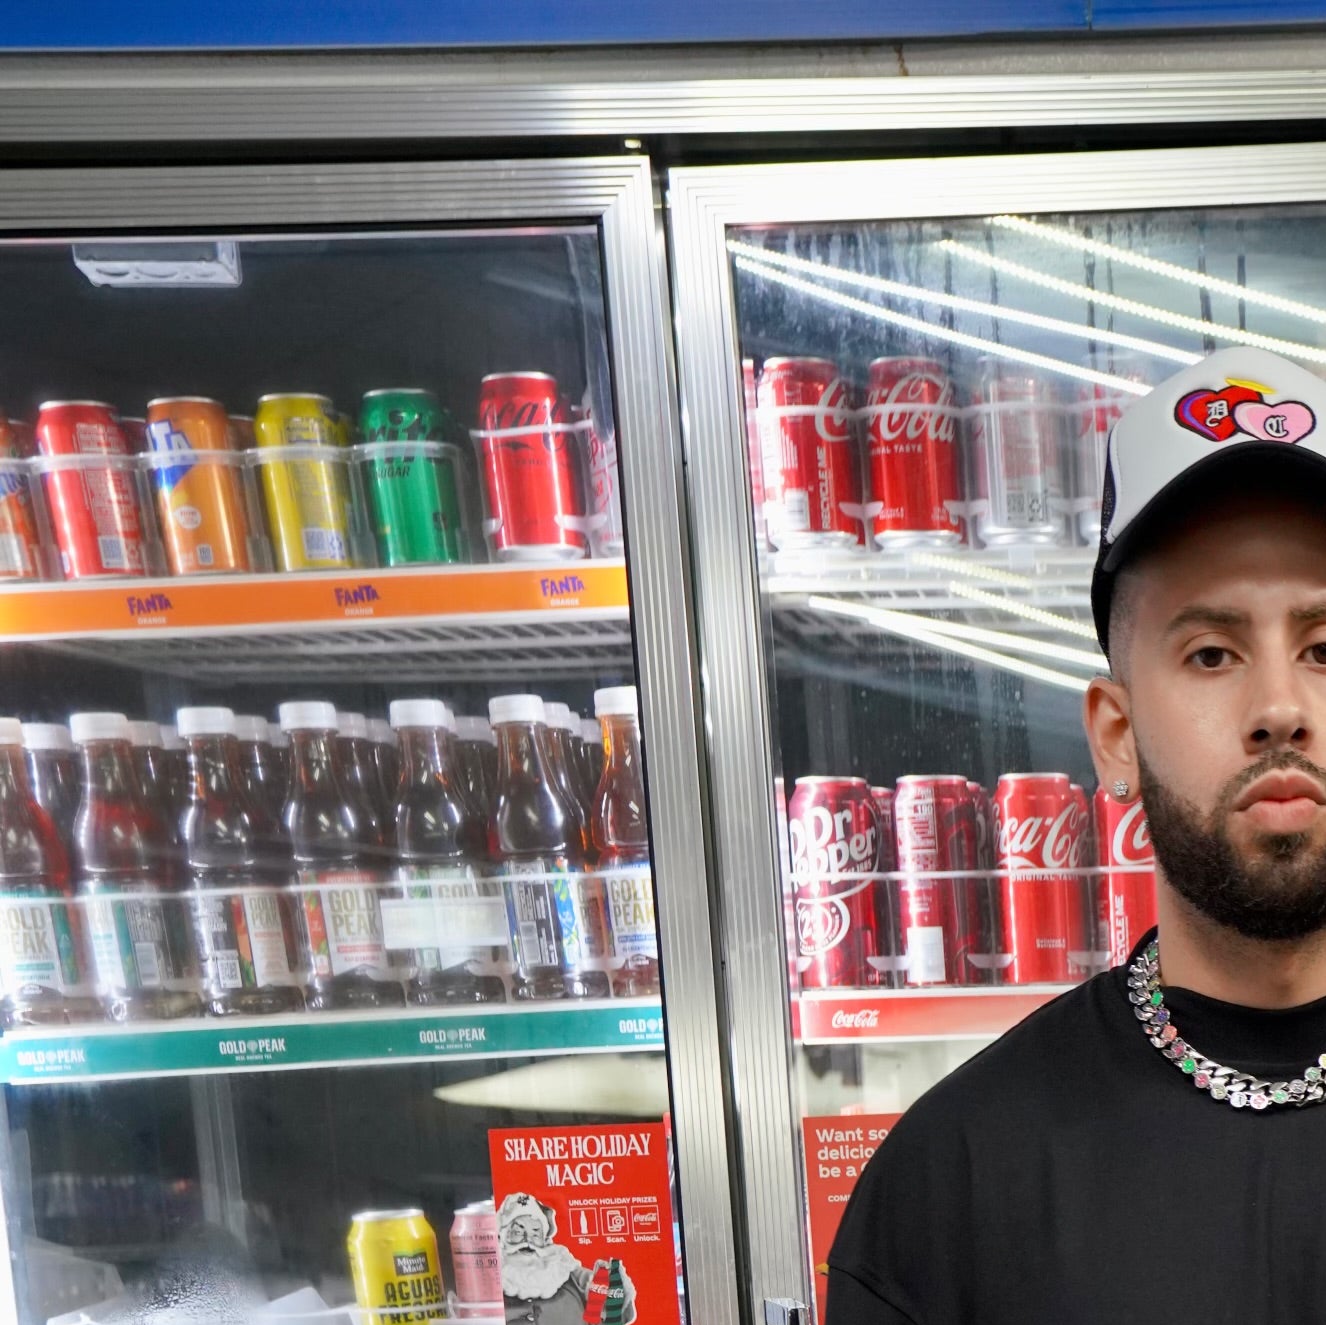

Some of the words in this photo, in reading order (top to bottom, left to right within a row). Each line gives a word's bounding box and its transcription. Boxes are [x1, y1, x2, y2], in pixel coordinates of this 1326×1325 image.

[819, 468, 830, 529] RECYCLE
[334, 584, 379, 605] FANTA
[541, 576, 585, 596] FANTA
[127, 593, 172, 616] FANTA
[809, 806, 852, 843] Dr
[328, 889, 376, 914] GOLD
[333, 913, 379, 937] PEAK
[619, 1019, 646, 1033] GOLD
[832, 1010, 879, 1028] Coca-Cola
[419, 1030, 446, 1044] GOLD
[459, 1028, 486, 1041] PEAK
[219, 1040, 246, 1055] GOLD
[258, 1038, 285, 1053] PEAK
[17, 1051, 44, 1066] GOLD
[57, 1048, 85, 1064] PEAK
[816, 1128, 863, 1143] Want
[504, 1137, 569, 1161] SHARE
[570, 1133, 652, 1159] HOLIDAY
[818, 1144, 878, 1160] delicio
[546, 1162, 615, 1187] MAGIC
[819, 1164, 841, 1178] be
[846, 1168, 857, 1177] a
[569, 1199, 598, 1207] UNLOCK
[600, 1197, 631, 1205] HOLIDAY
[634, 1234, 661, 1242] Unlock.
[397, 1256, 426, 1266] Minute
[403, 1264, 425, 1274] Maid
[384, 1276, 441, 1302] AGUAS
